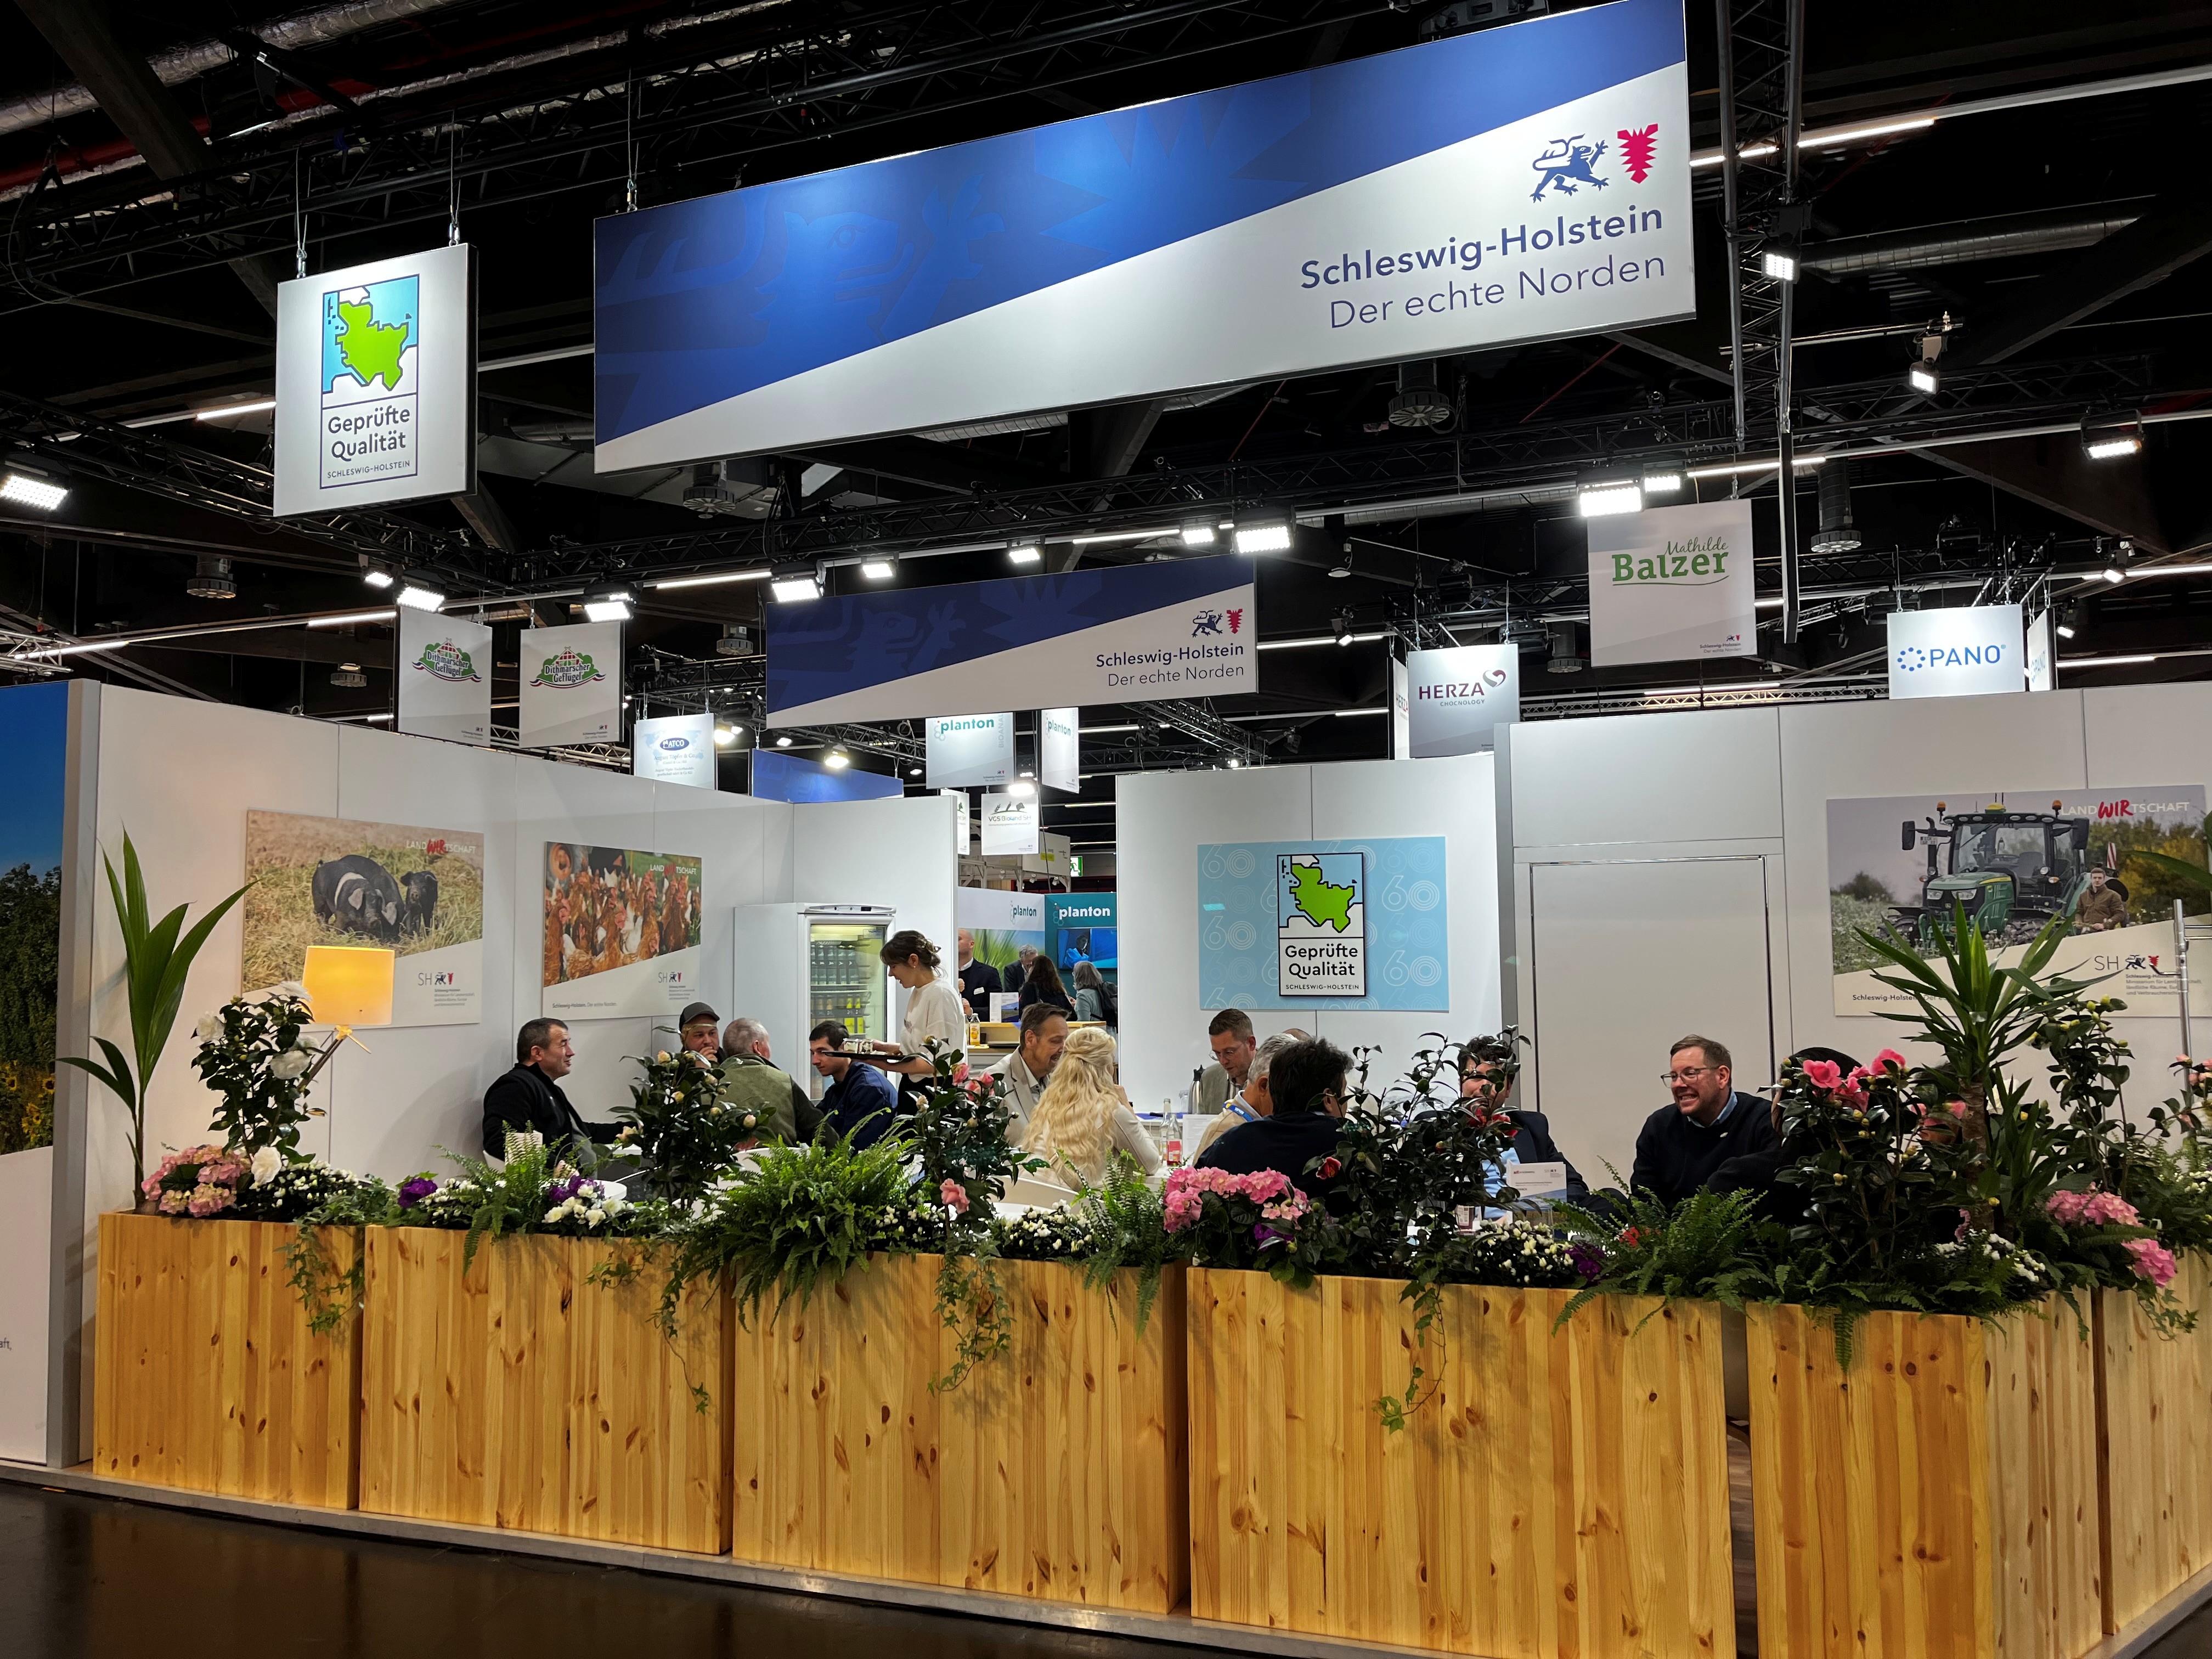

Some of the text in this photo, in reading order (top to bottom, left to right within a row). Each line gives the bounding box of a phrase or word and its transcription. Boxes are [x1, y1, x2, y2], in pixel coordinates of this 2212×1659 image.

[1301, 205, 1663, 289] Schleswig-Holstein
[1330, 255, 1665, 329] Der echte Norden
[328, 405, 411, 435] Geprüfte
[331, 429, 406, 462] Qualität
[327, 460, 410, 479] SCHLESWIG-HOLSTEIN
[1664, 537, 1729, 556] Mathilde
[1611, 551, 1729, 582] Balzer
[427, 651, 469, 669] Dithmarscher
[1096, 642, 1244, 668] Schleswig-Holstein
[1929, 645, 2001, 668] PANO
[435, 662, 461, 677] Geflügel
[545, 663, 590, 674] Dithmarscher
[553, 672, 582, 682] Geflügel
[1108, 663, 1244, 687] Der echte Norden
[1419, 682, 1485, 700] HERZA
[941, 718, 994, 735] planton
[1048, 719, 1071, 736] planton
[2060, 799, 2190, 819] LANDWIRTSCHAFT
[1381, 875, 1440, 911] 60
[1013, 905, 1037, 918] planton
[1058, 906, 1111, 920] planton
[1285, 943, 1358, 961] Geprüfte
[1289, 961, 1355, 979] Qualität
[1383, 950, 1442, 986] 60
[2094, 955, 2119, 971] SH
[418, 972, 432, 986] SH
[658, 972, 668, 983] SH
